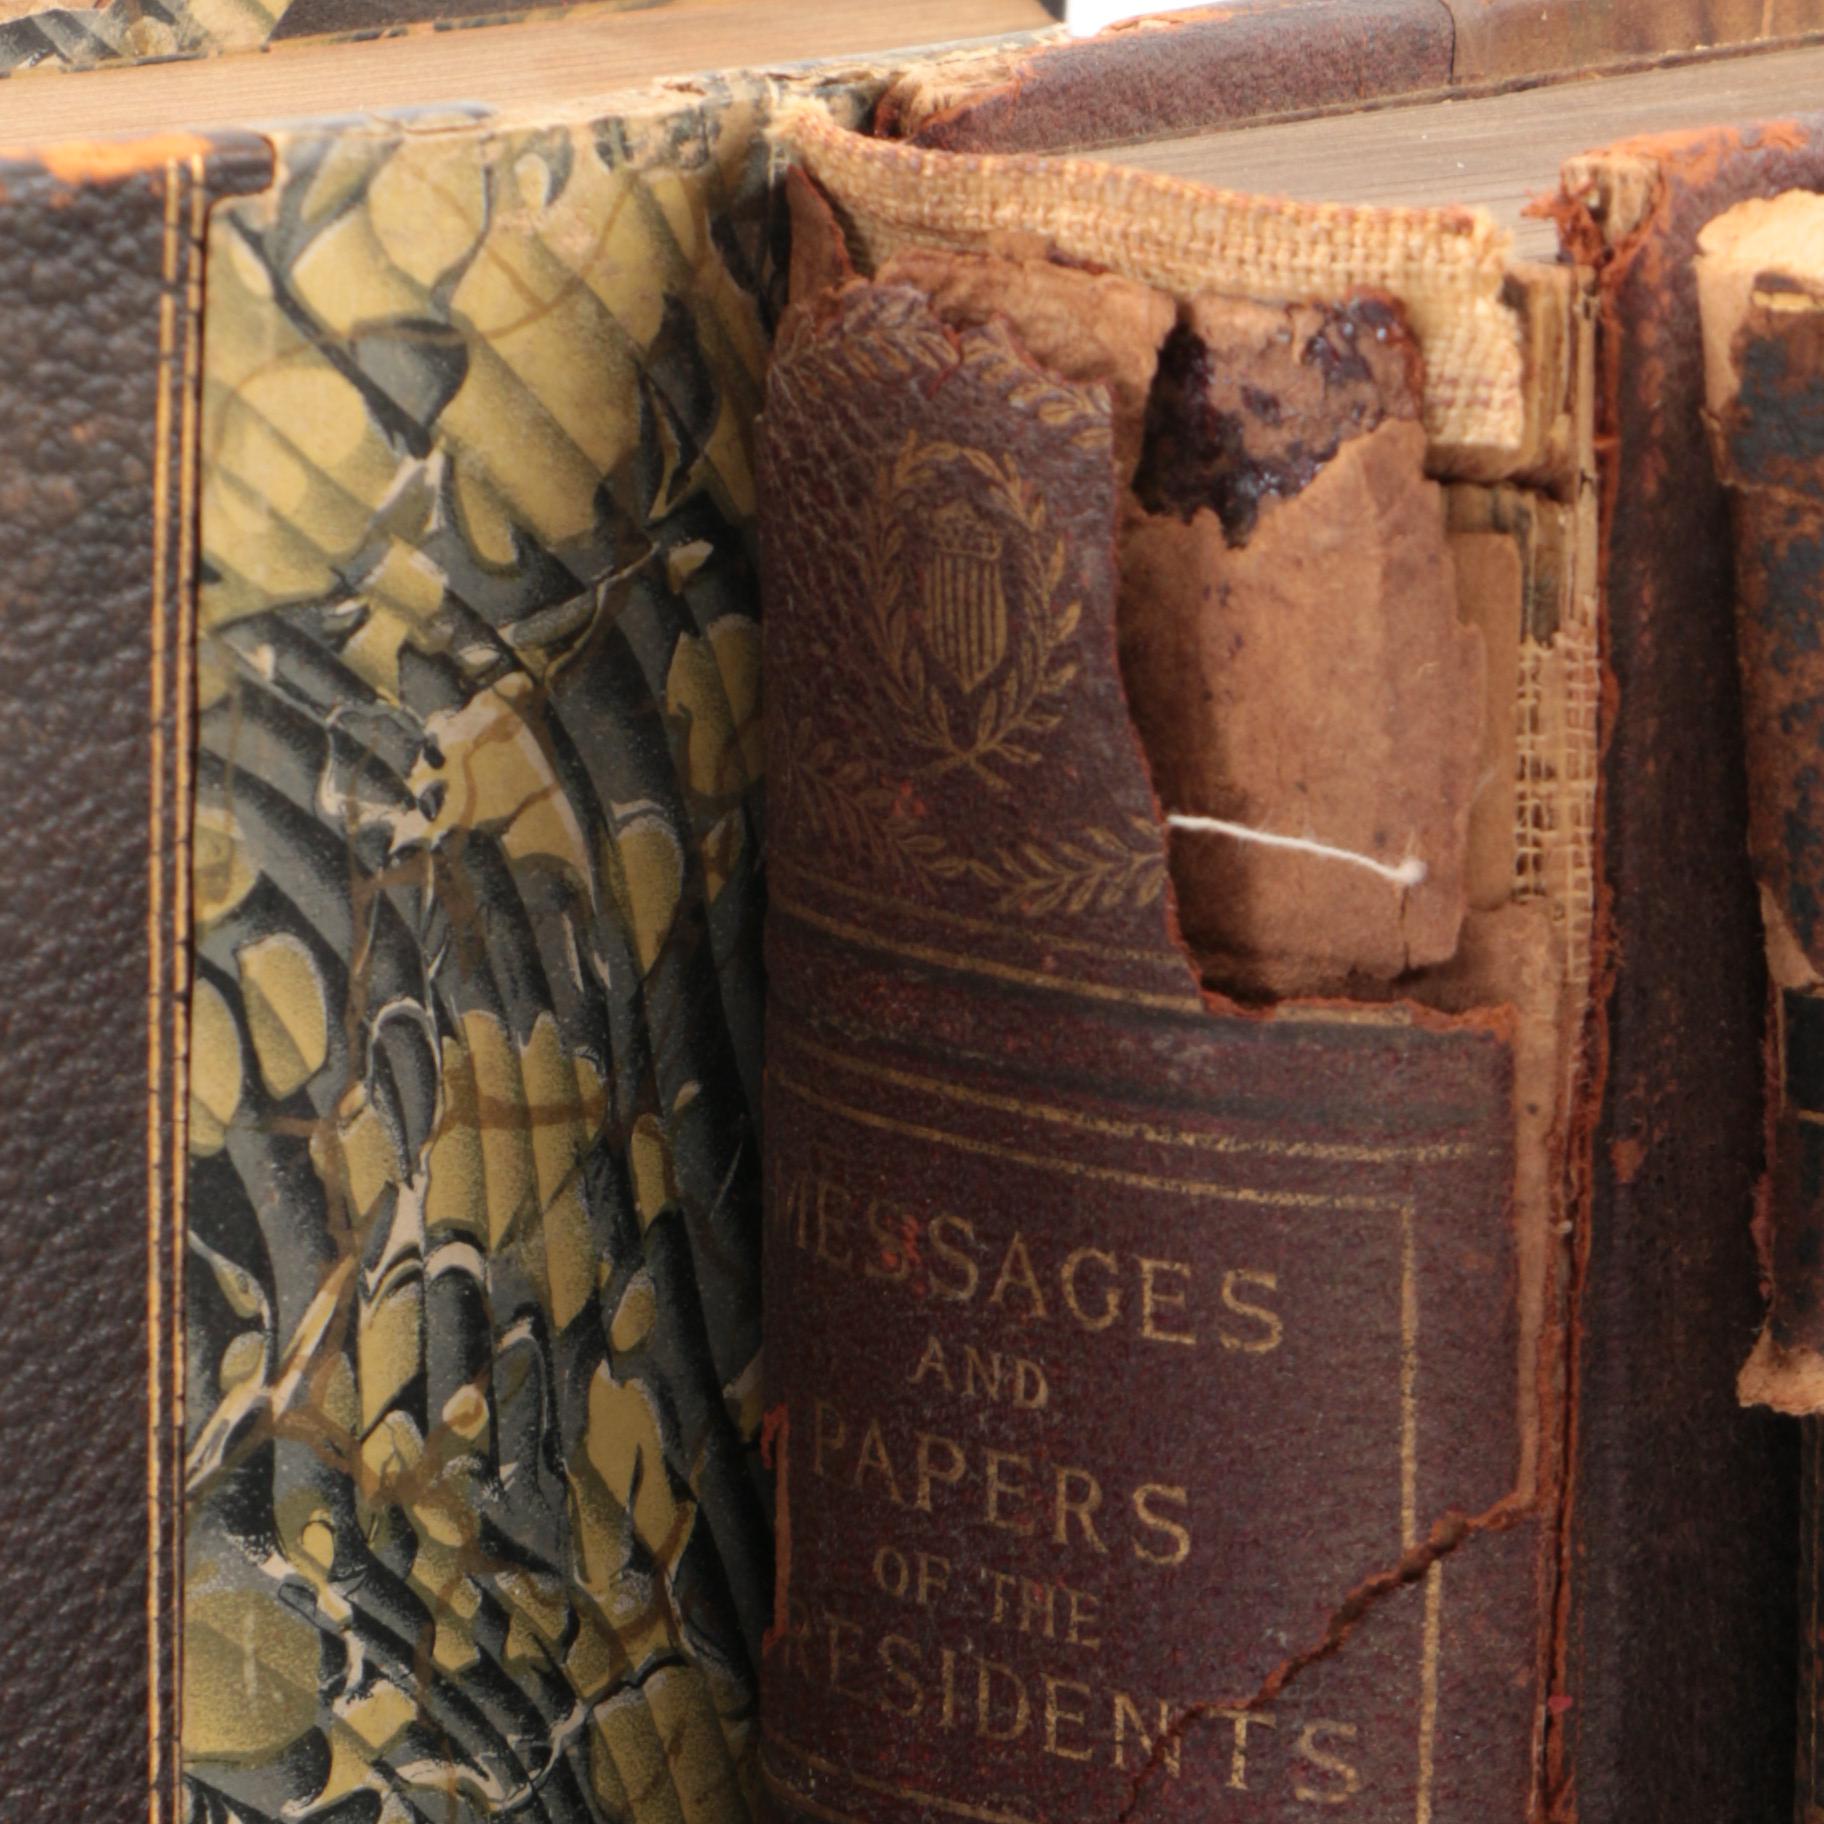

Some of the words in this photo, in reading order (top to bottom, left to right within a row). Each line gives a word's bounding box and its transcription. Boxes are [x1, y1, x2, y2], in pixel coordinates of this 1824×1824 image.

[908, 1336, 1049, 1410] AND
[812, 1402, 1191, 1567] PAPERS
[872, 1546, 950, 1606] OF
[985, 1567, 1102, 1651] THE
[782, 1598, 1366, 1803] RESIDENTS
